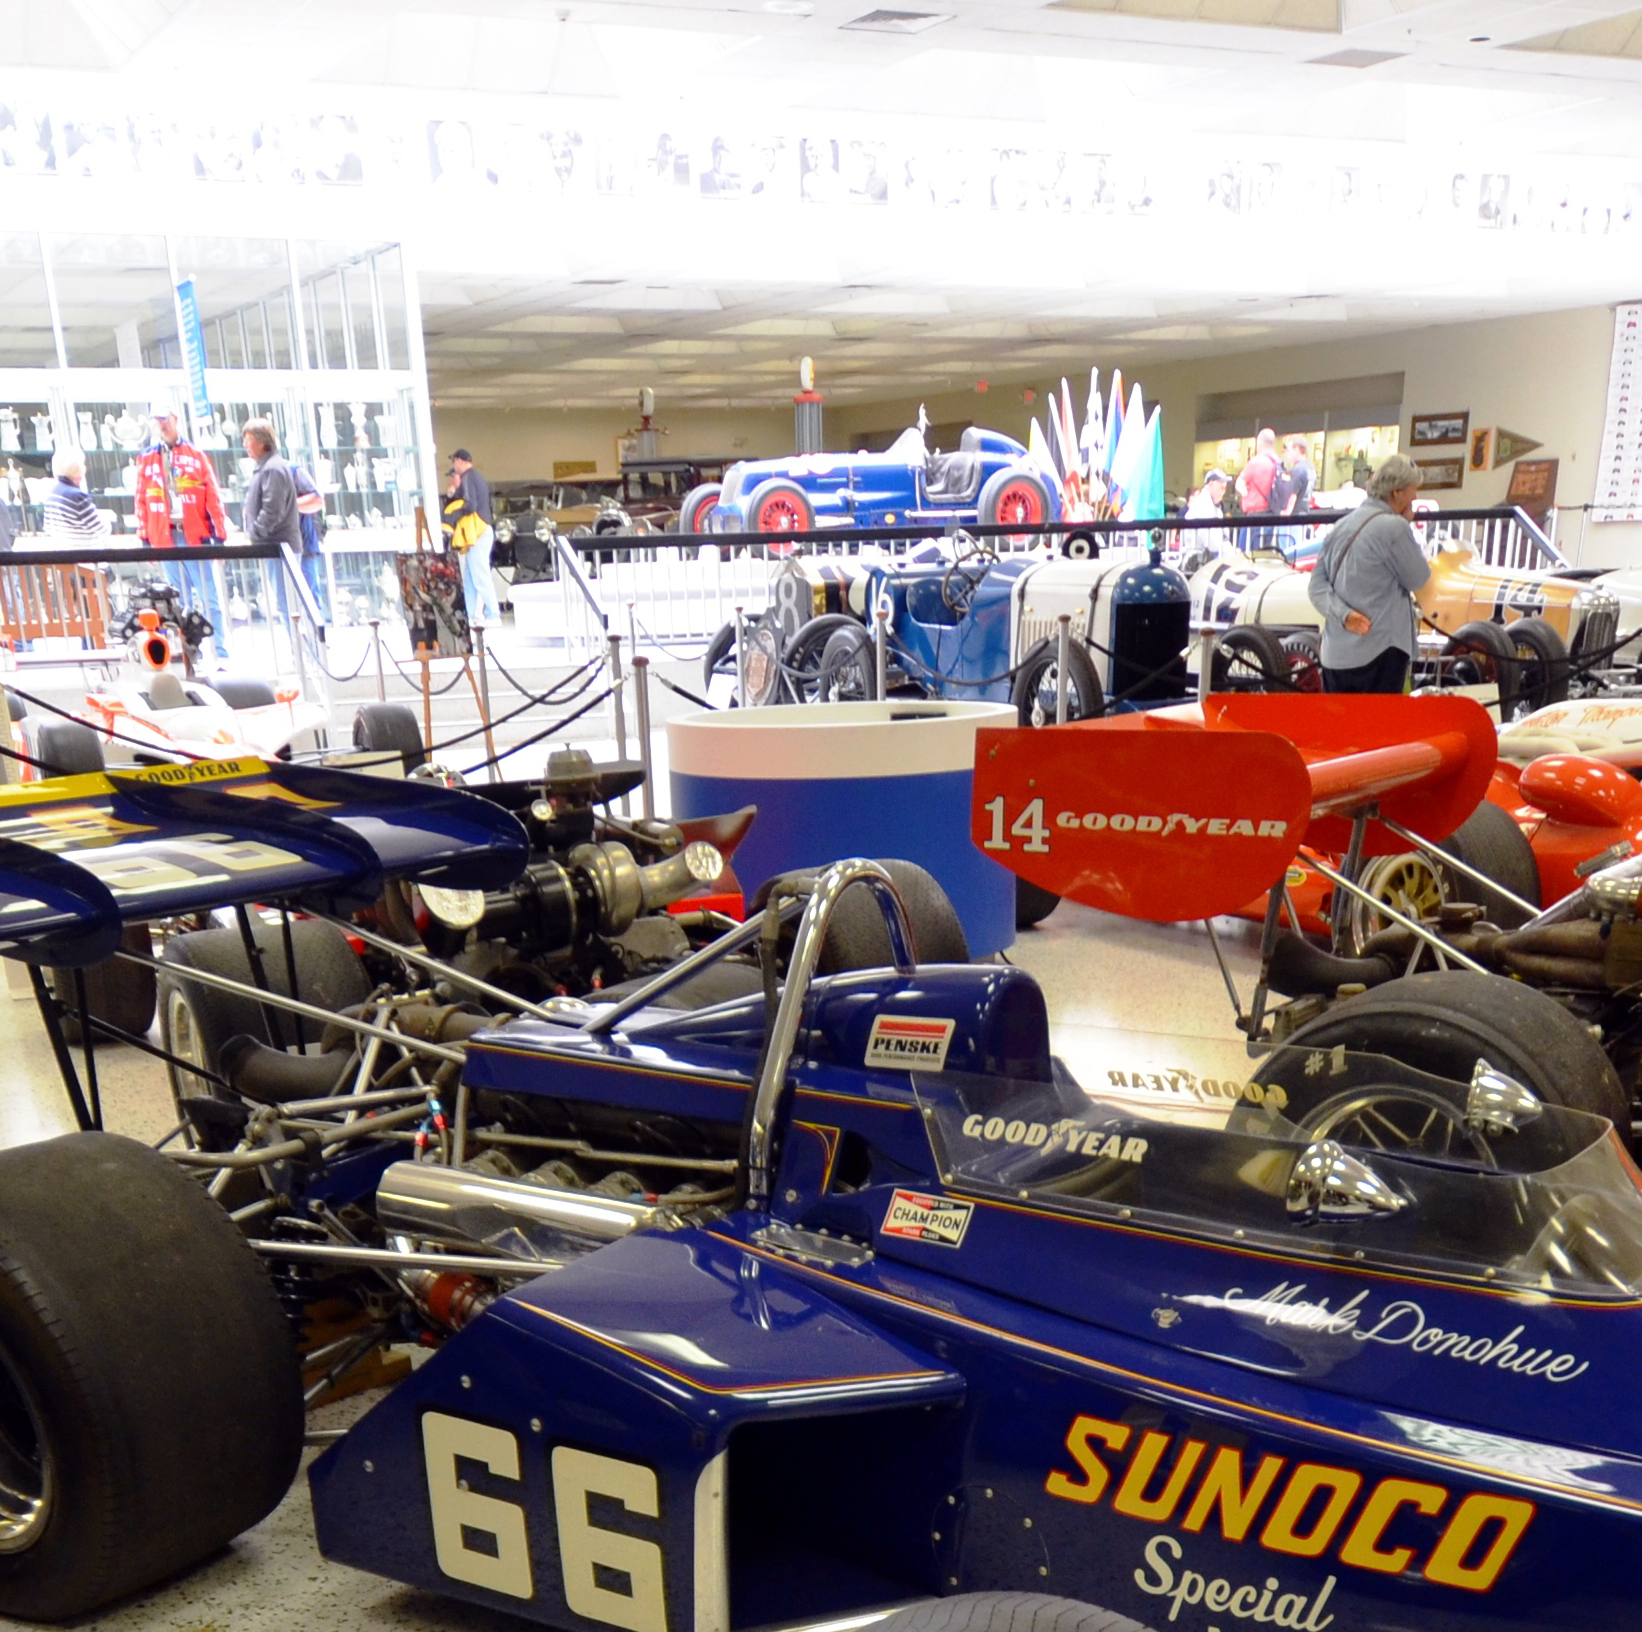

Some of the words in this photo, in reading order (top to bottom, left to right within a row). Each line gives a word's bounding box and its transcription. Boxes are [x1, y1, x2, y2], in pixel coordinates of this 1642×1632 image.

[983, 795, 1051, 853] 14
[1056, 810, 1287, 839] GOODYEAR
[873, 1037, 942, 1056] PENSKE
[962, 1113, 1149, 1165] GOODYEAR
[893, 1205, 963, 1232] CHAMPION
[1351, 1297, 1591, 1383] Donohue
[1044, 1412, 1538, 1593] SUNOCO
